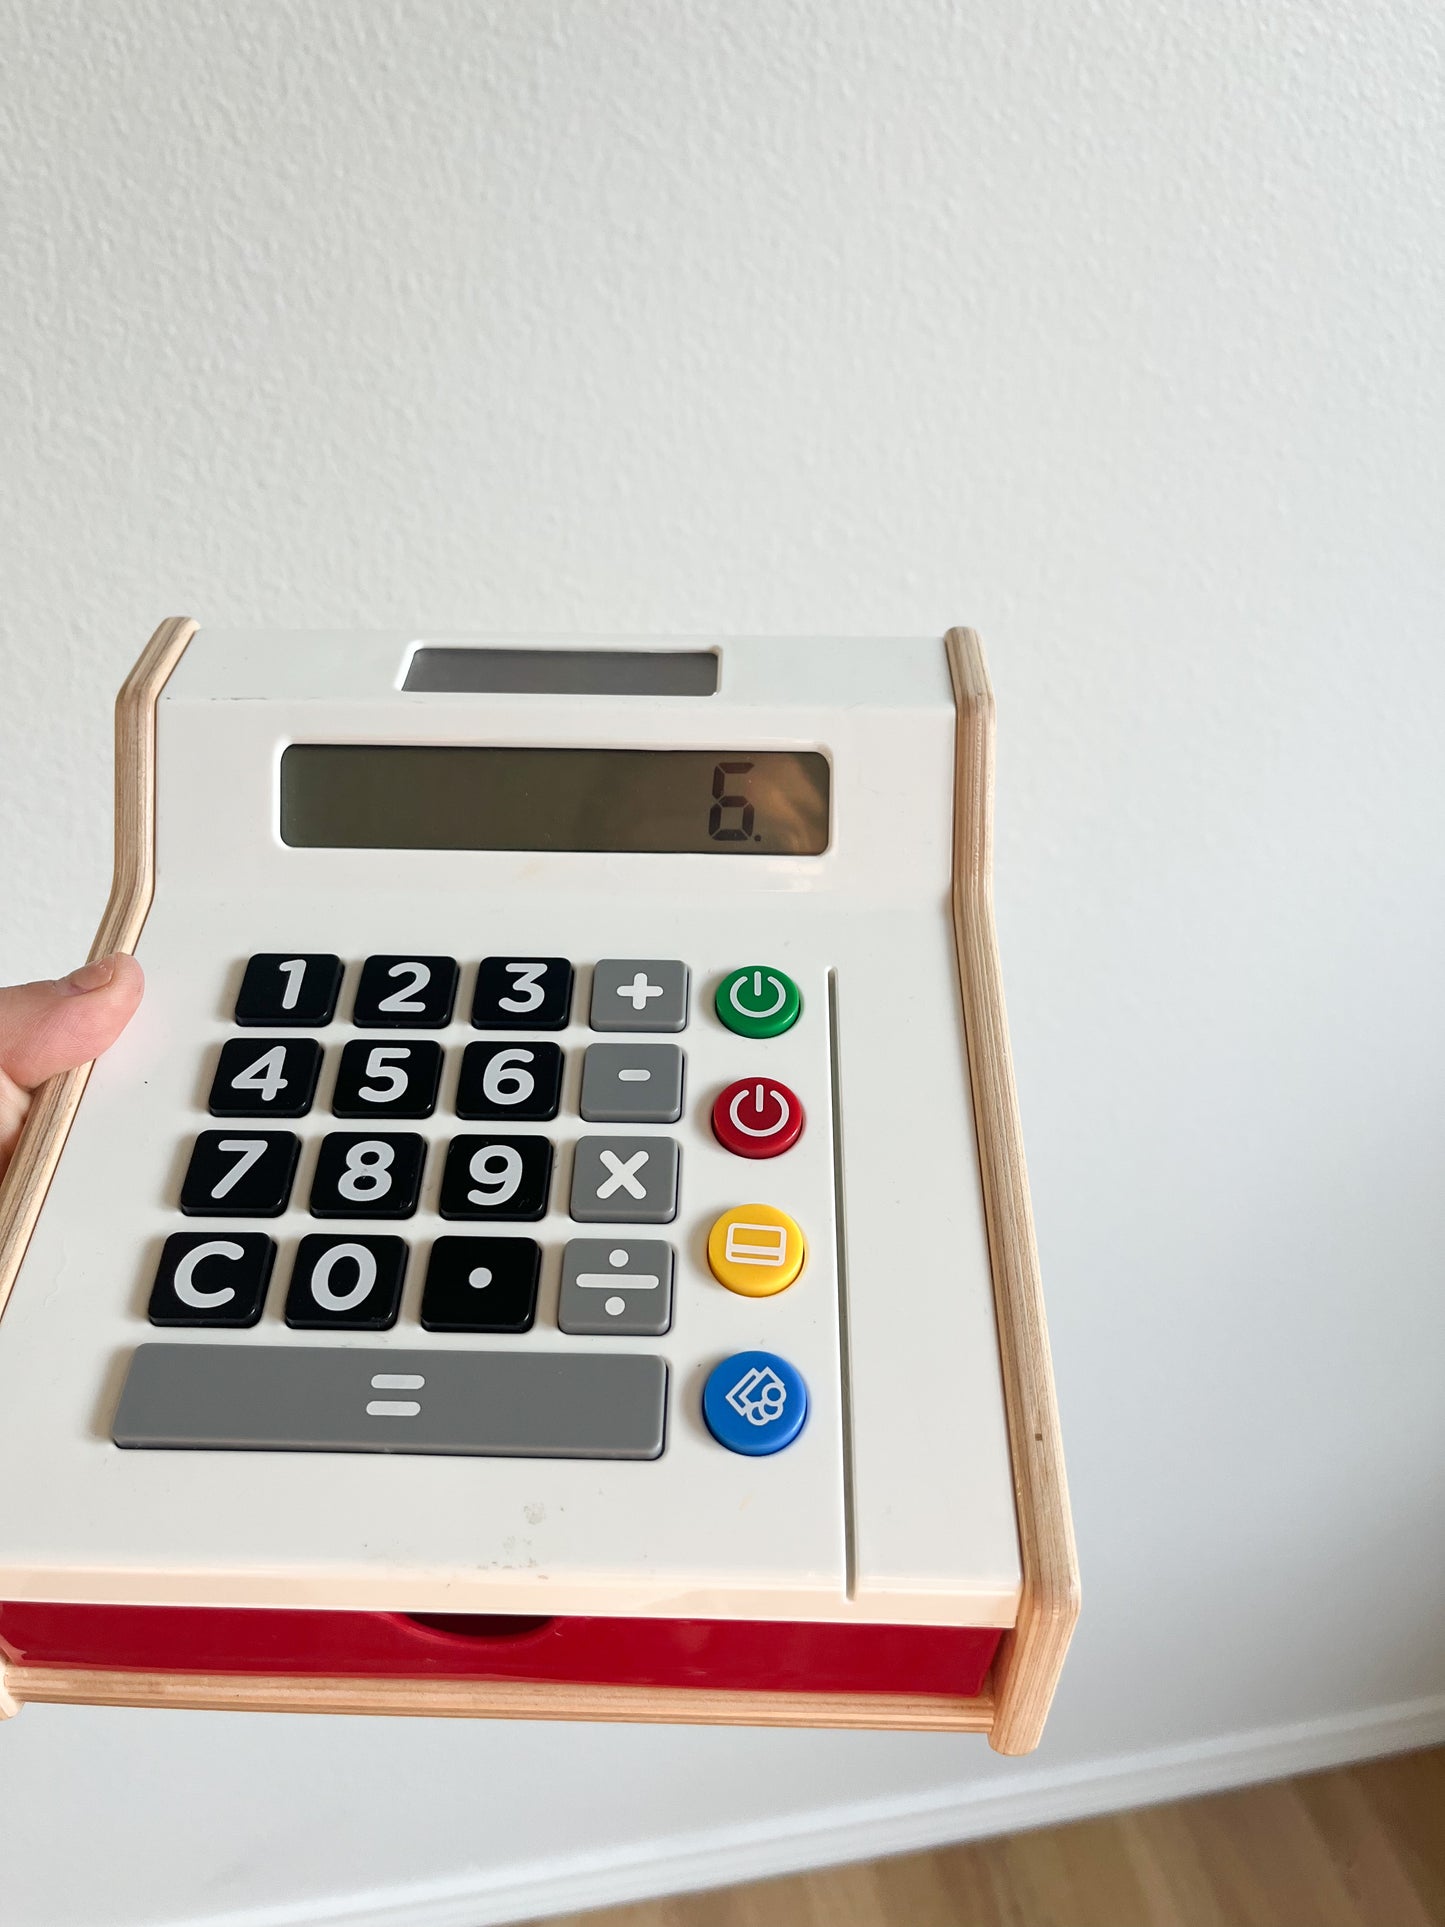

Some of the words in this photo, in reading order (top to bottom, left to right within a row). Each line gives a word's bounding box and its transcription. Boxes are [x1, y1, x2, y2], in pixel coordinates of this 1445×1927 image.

[708, 762, 761, 841] 6.
[278, 959, 307, 1010] 1
[378, 961, 431, 1013] 2
[498, 962, 548, 1013] 3
[616, 972, 664, 1010] +
[230, 1045, 289, 1102] 4
[358, 1047, 411, 1103] 5
[482, 1048, 535, 1105] 6
[210, 1139, 269, 1199] 7
[337, 1140, 395, 1202] 8
[467, 1144, 523, 1206] 9
[173, 1240, 245, 1309] C
[310, 1242, 377, 1312] 0
[576, 1249, 660, 1316] ÷
[366, 1374, 425, 1416] =
